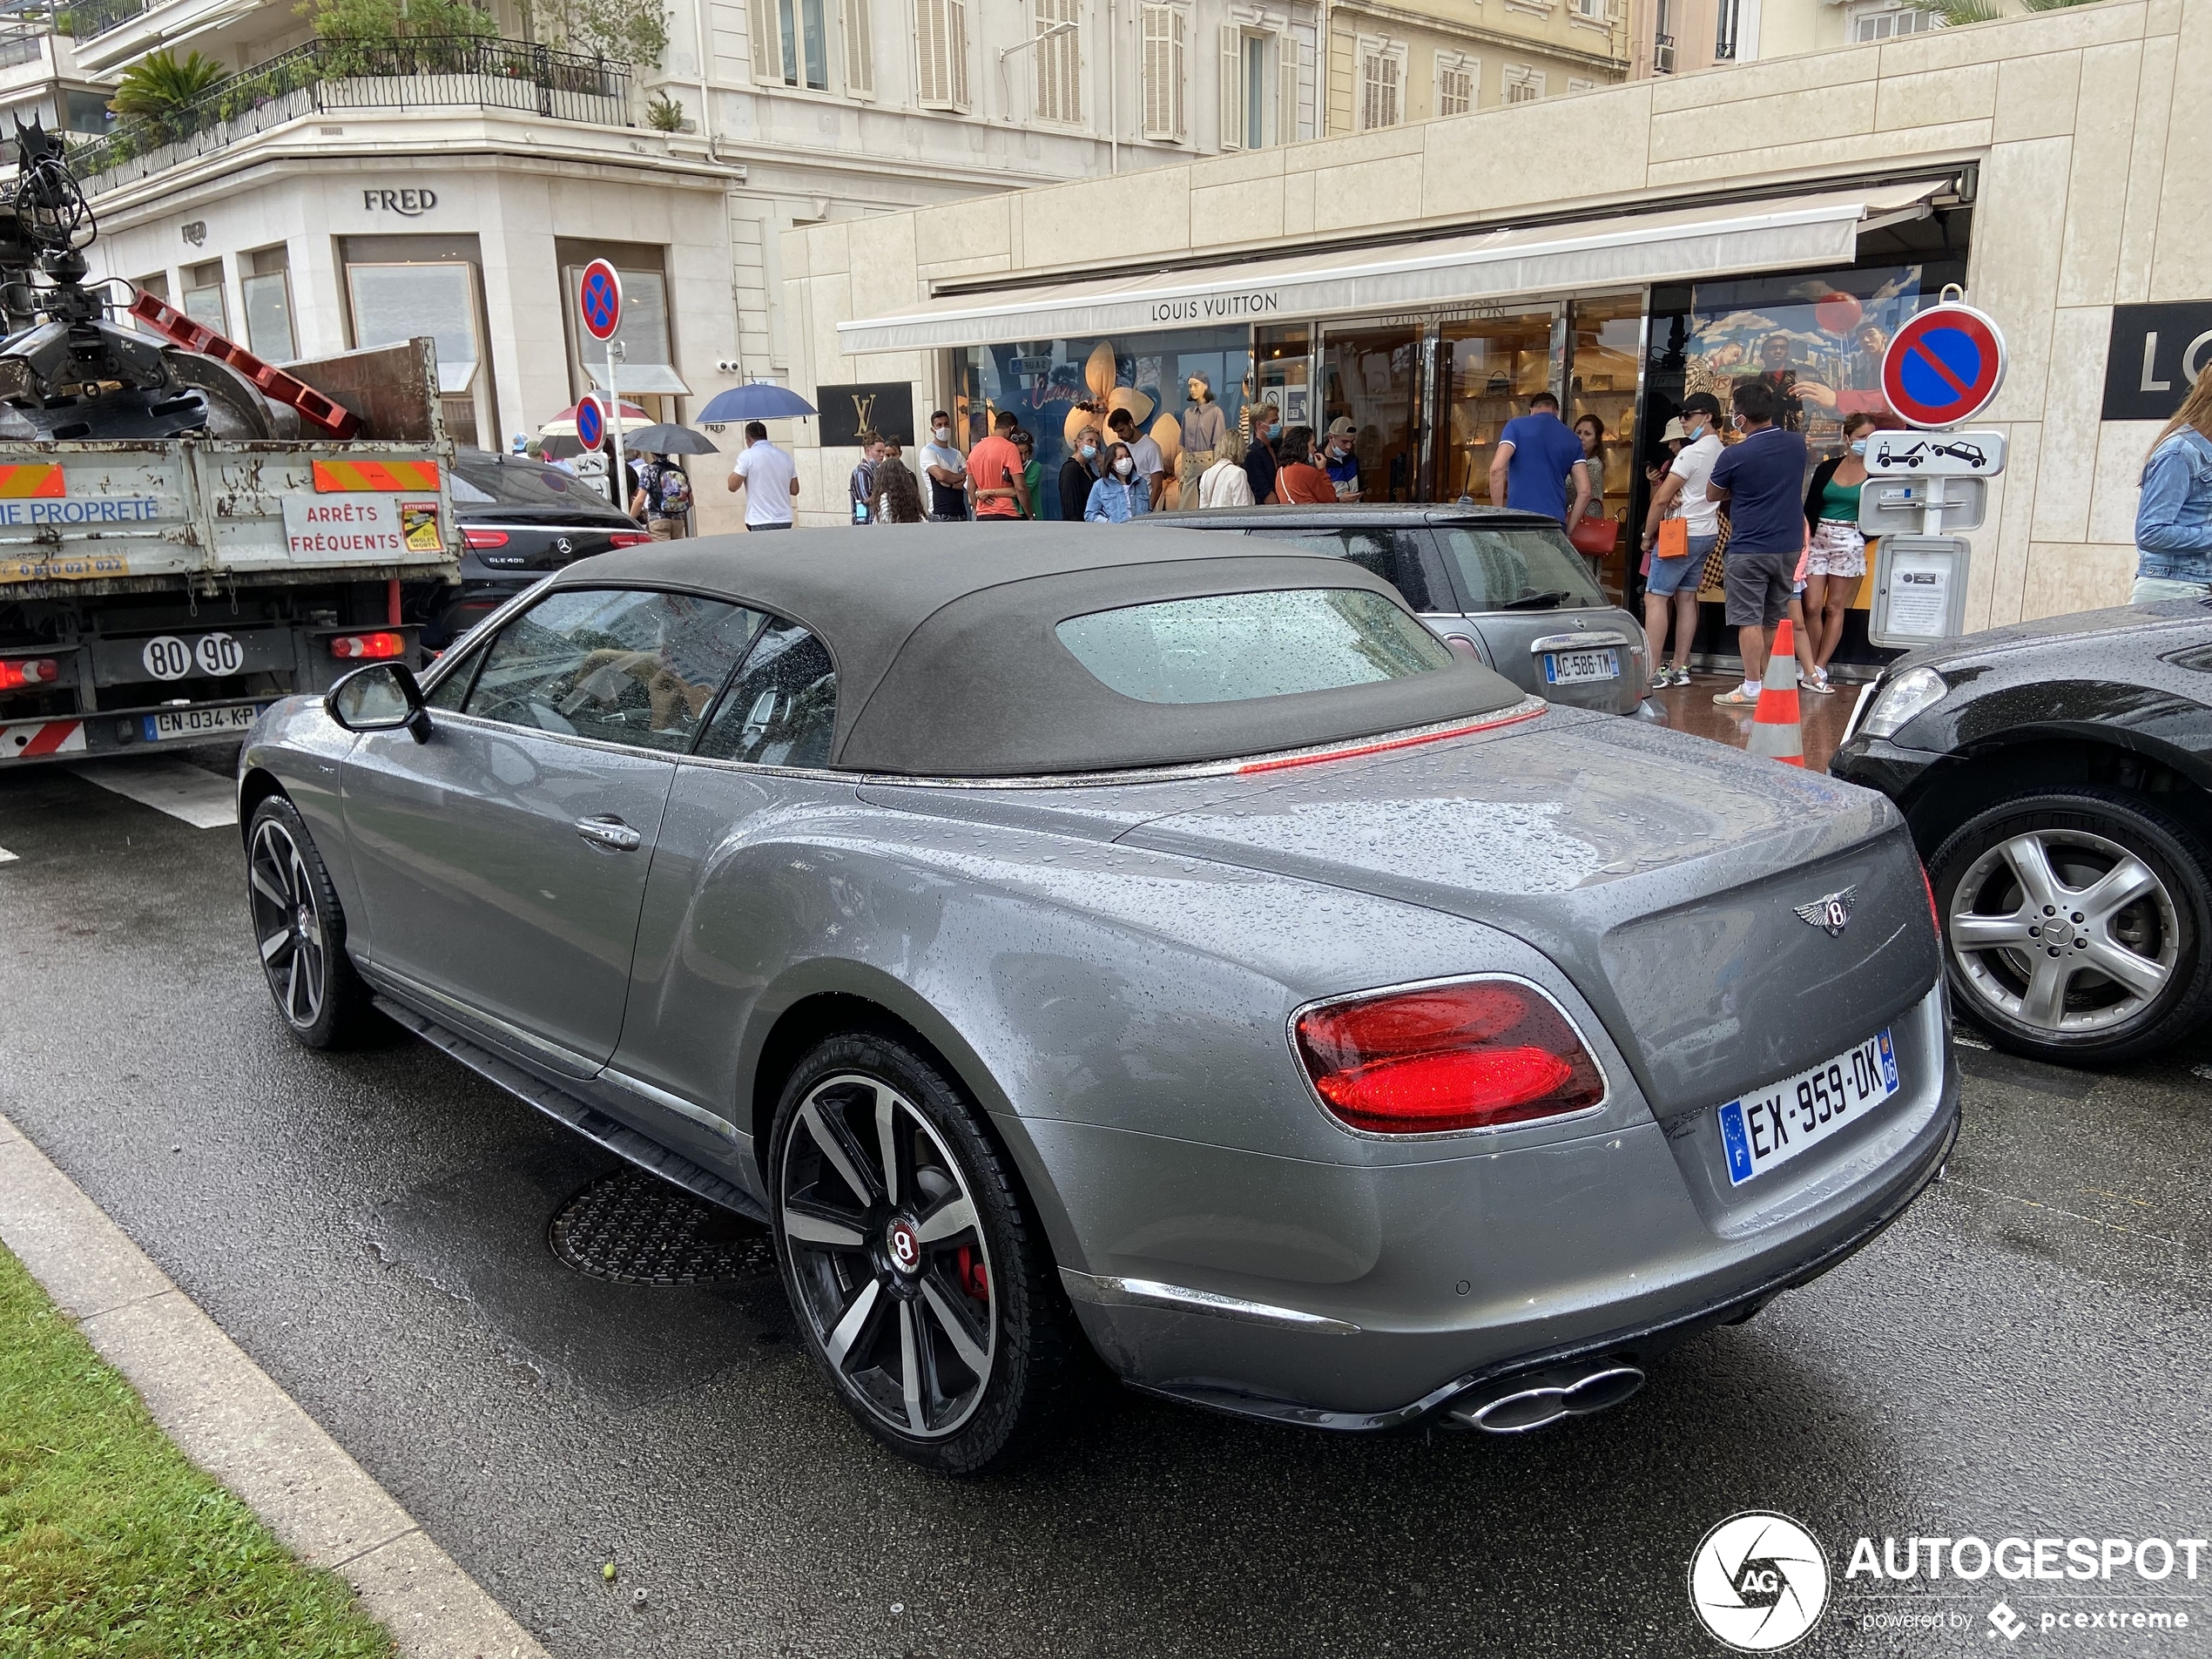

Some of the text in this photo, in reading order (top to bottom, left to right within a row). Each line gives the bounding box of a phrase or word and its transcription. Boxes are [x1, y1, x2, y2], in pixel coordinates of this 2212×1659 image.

[363, 189, 438, 217] FRED
[1152, 293, 1277, 320] LOUIS VUITTON
[705, 424, 725, 434] FRED
[30, 496, 158, 523] PROPRETÉ
[307, 503, 378, 523] ARRÊTS
[290, 533, 399, 551] FRÉQUENTS
[95, 559, 121, 571] 022
[150, 643, 185, 675] 80
[203, 637, 237, 671] 90
[1557, 653, 1611, 678] AC-586-TM
[159, 709, 253, 732] CN-034-KP
[1884, 1058, 1896, 1084] 06
[1747, 1042, 1883, 1160] EX-959-DK
[1735, 1149, 1743, 1168] F
